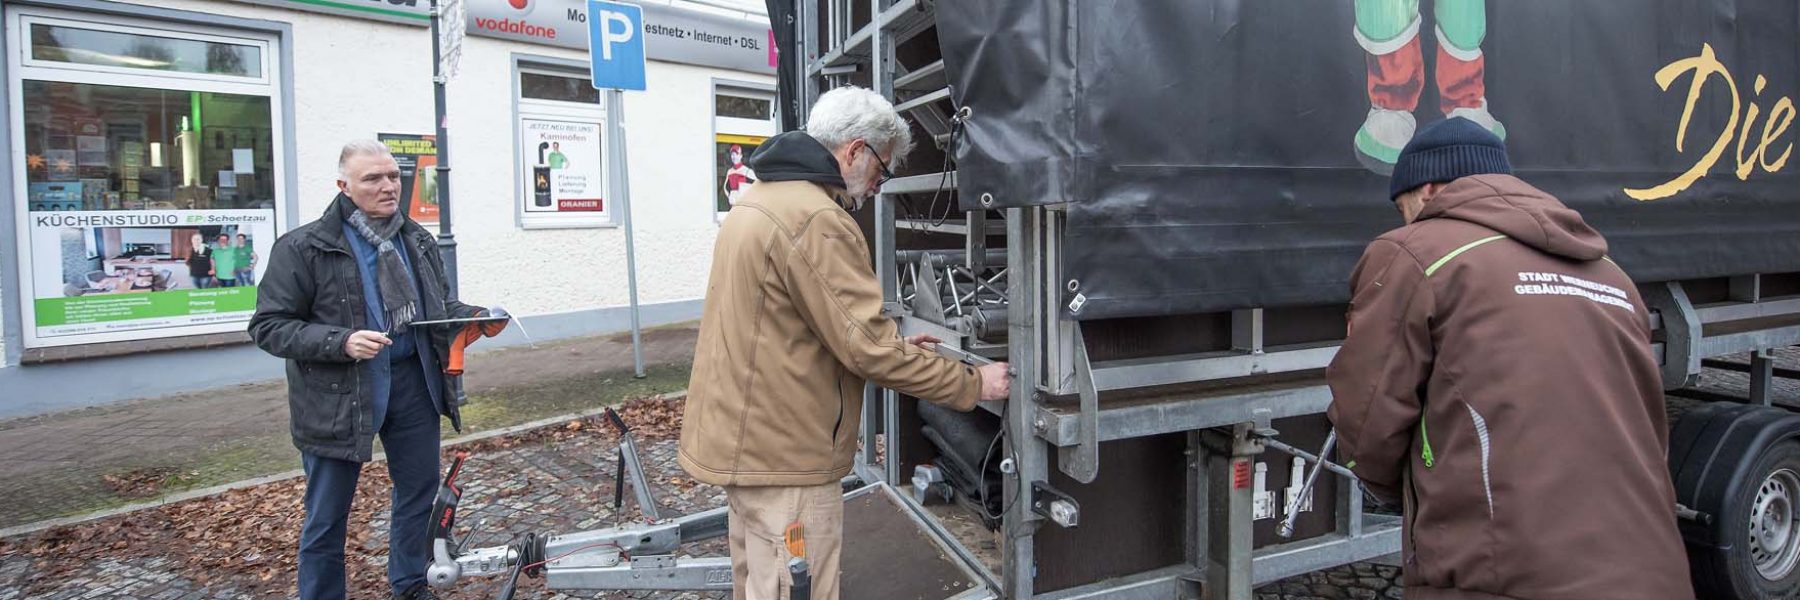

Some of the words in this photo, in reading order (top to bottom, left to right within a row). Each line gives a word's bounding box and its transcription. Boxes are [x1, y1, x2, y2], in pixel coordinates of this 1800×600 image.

[475, 16, 556, 39] vodafone
[567, 8, 586, 23] Mo
[644, 22, 684, 39] estnetz
[693, 29, 732, 47] Internet
[740, 37, 760, 50] DSL
[600, 10, 634, 61] P
[1623, 42, 1797, 201] Die
[540, 132, 587, 142] Kaminofen
[405, 146, 437, 155] DEMAN
[36, 213, 179, 228] KÜCHENSTUDIO
[1518, 271, 1559, 282] STADT
